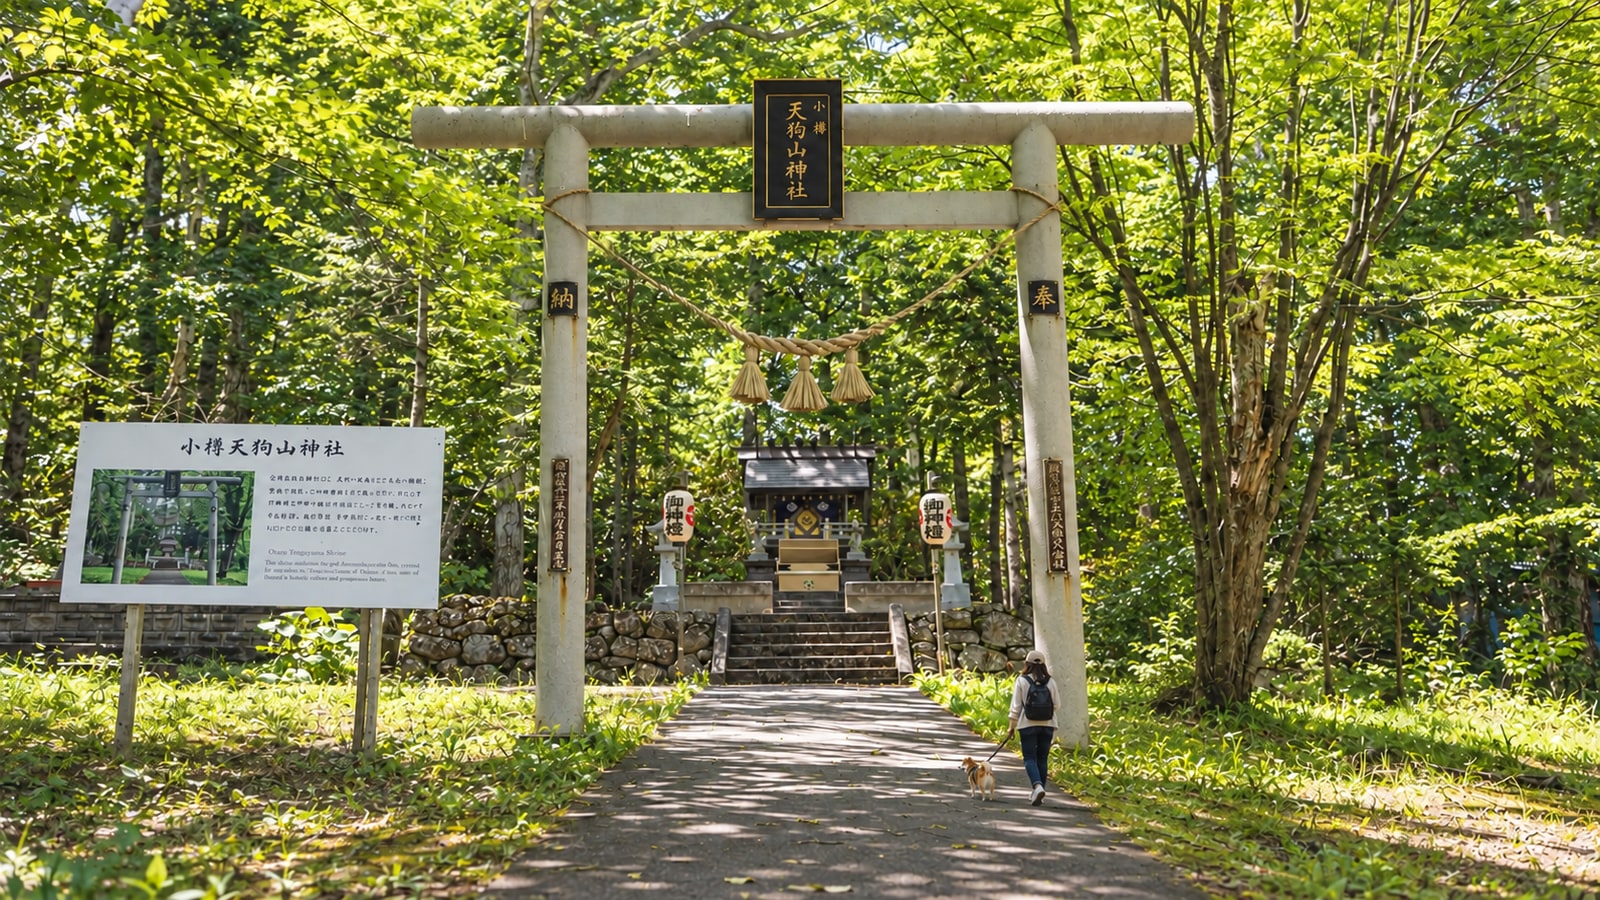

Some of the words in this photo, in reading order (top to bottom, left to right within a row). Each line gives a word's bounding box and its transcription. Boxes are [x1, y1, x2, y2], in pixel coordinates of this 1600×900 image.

[813, 100, 827, 135] 小樽
[786, 101, 808, 201] 天狗山神社
[551, 287, 574, 310] 納
[1032, 284, 1056, 310] 奉
[180, 437, 345, 458] 小樽天狗山神社
